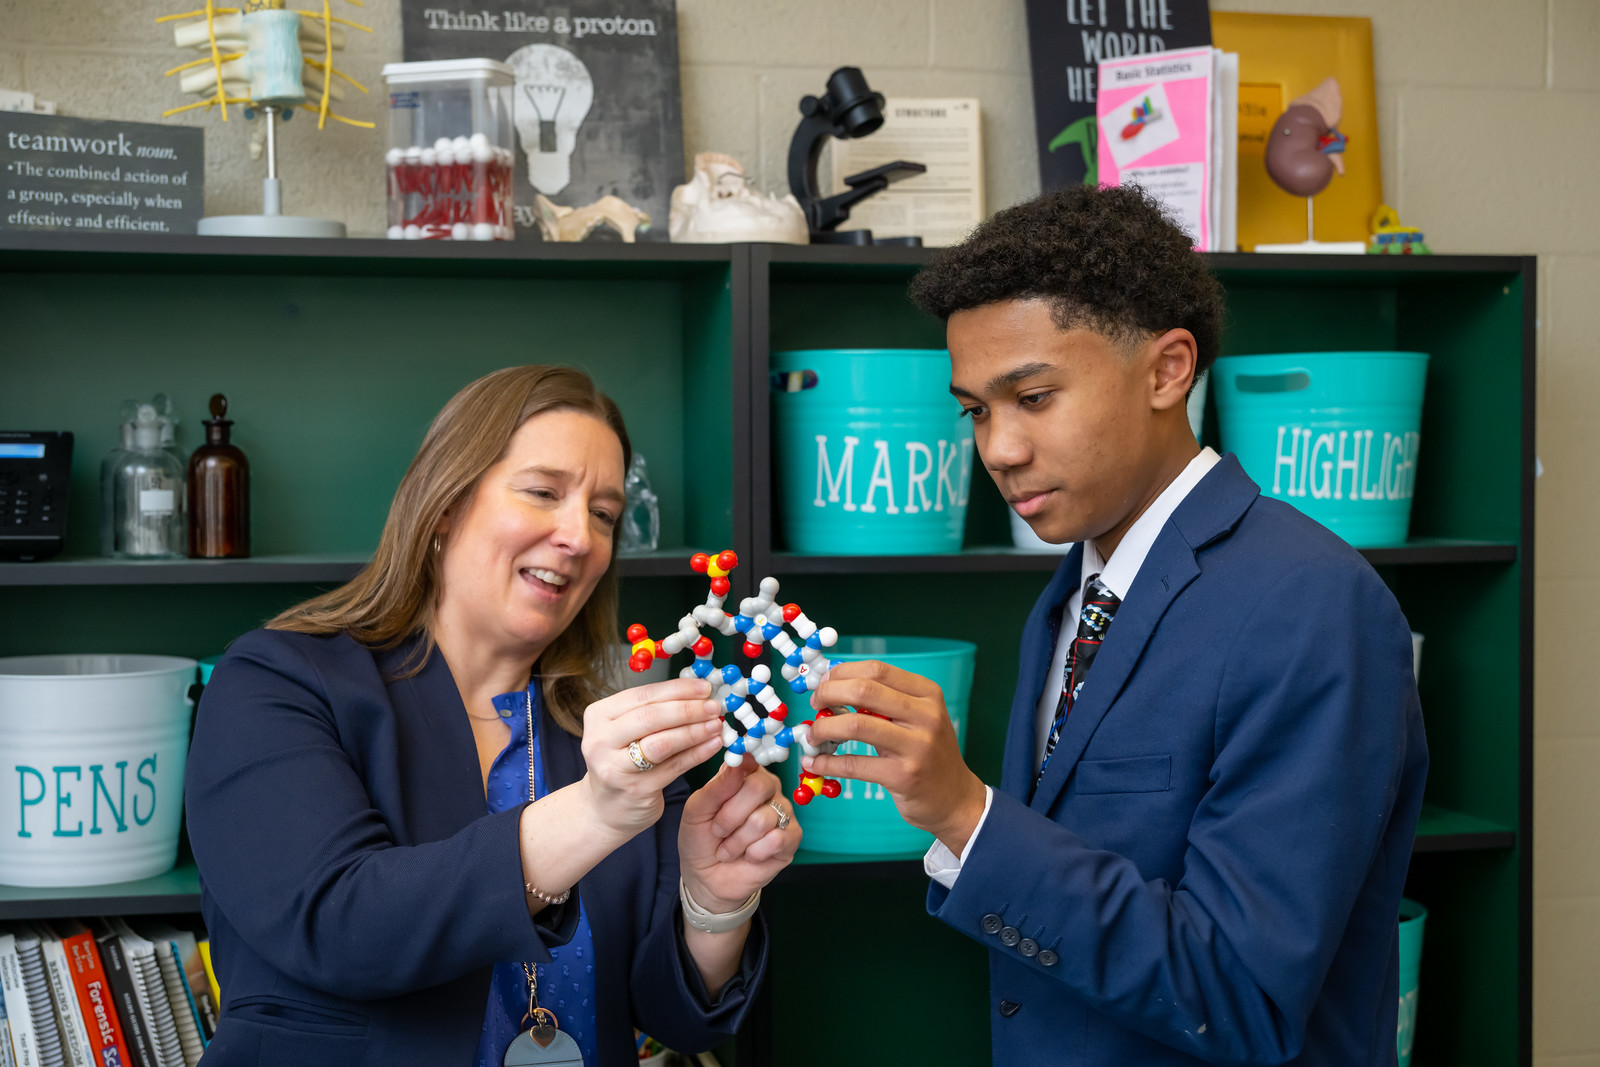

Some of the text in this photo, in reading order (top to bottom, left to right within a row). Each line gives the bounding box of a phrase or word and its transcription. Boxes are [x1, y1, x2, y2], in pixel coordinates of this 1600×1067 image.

[424, 9, 656, 38] Think like a proton
[1115, 62, 1192, 81] Basic Statistics
[7, 131, 178, 160] teamwork noun.
[47, 163, 120, 182] combined
[123, 171, 169, 185] action
[171, 171, 188, 186] of
[7, 188, 183, 210] a group, especially when
[7, 209, 170, 232] effective and efficient.
[15, 752, 157, 838] PENS
[49, 961, 69, 1012] BATTLING
[64, 1014, 83, 1066] BOREDOM
[88, 981, 114, 1045] Forensic
